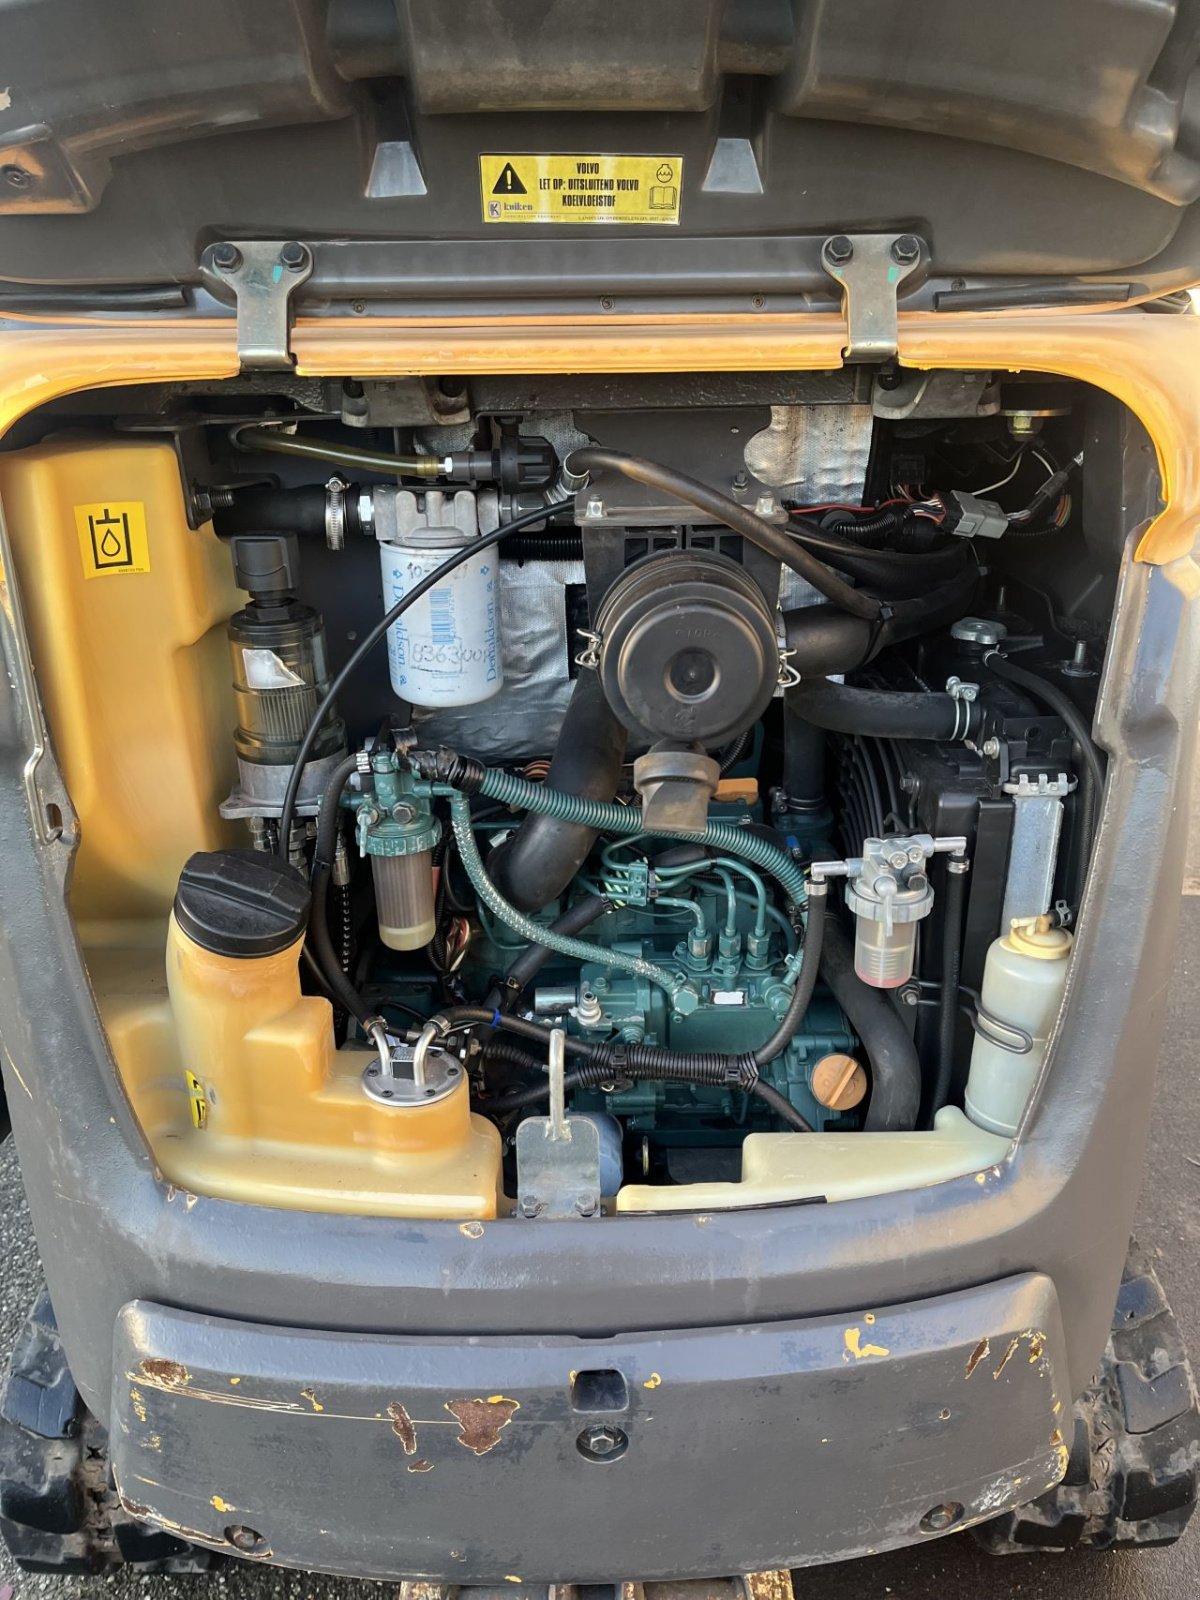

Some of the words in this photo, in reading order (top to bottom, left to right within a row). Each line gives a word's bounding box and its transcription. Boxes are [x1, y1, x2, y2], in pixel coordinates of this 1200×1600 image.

[576, 162, 600, 174] VOLVO
[539, 178, 551, 190] LET
[553, 179, 566, 190] OP:
[568, 179, 615, 191] UITSLUITEND
[616, 179, 639, 191] VOLVO
[562, 194, 616, 207] KOELVLOEISTOF
[393, 585, 408, 665] Daldson
